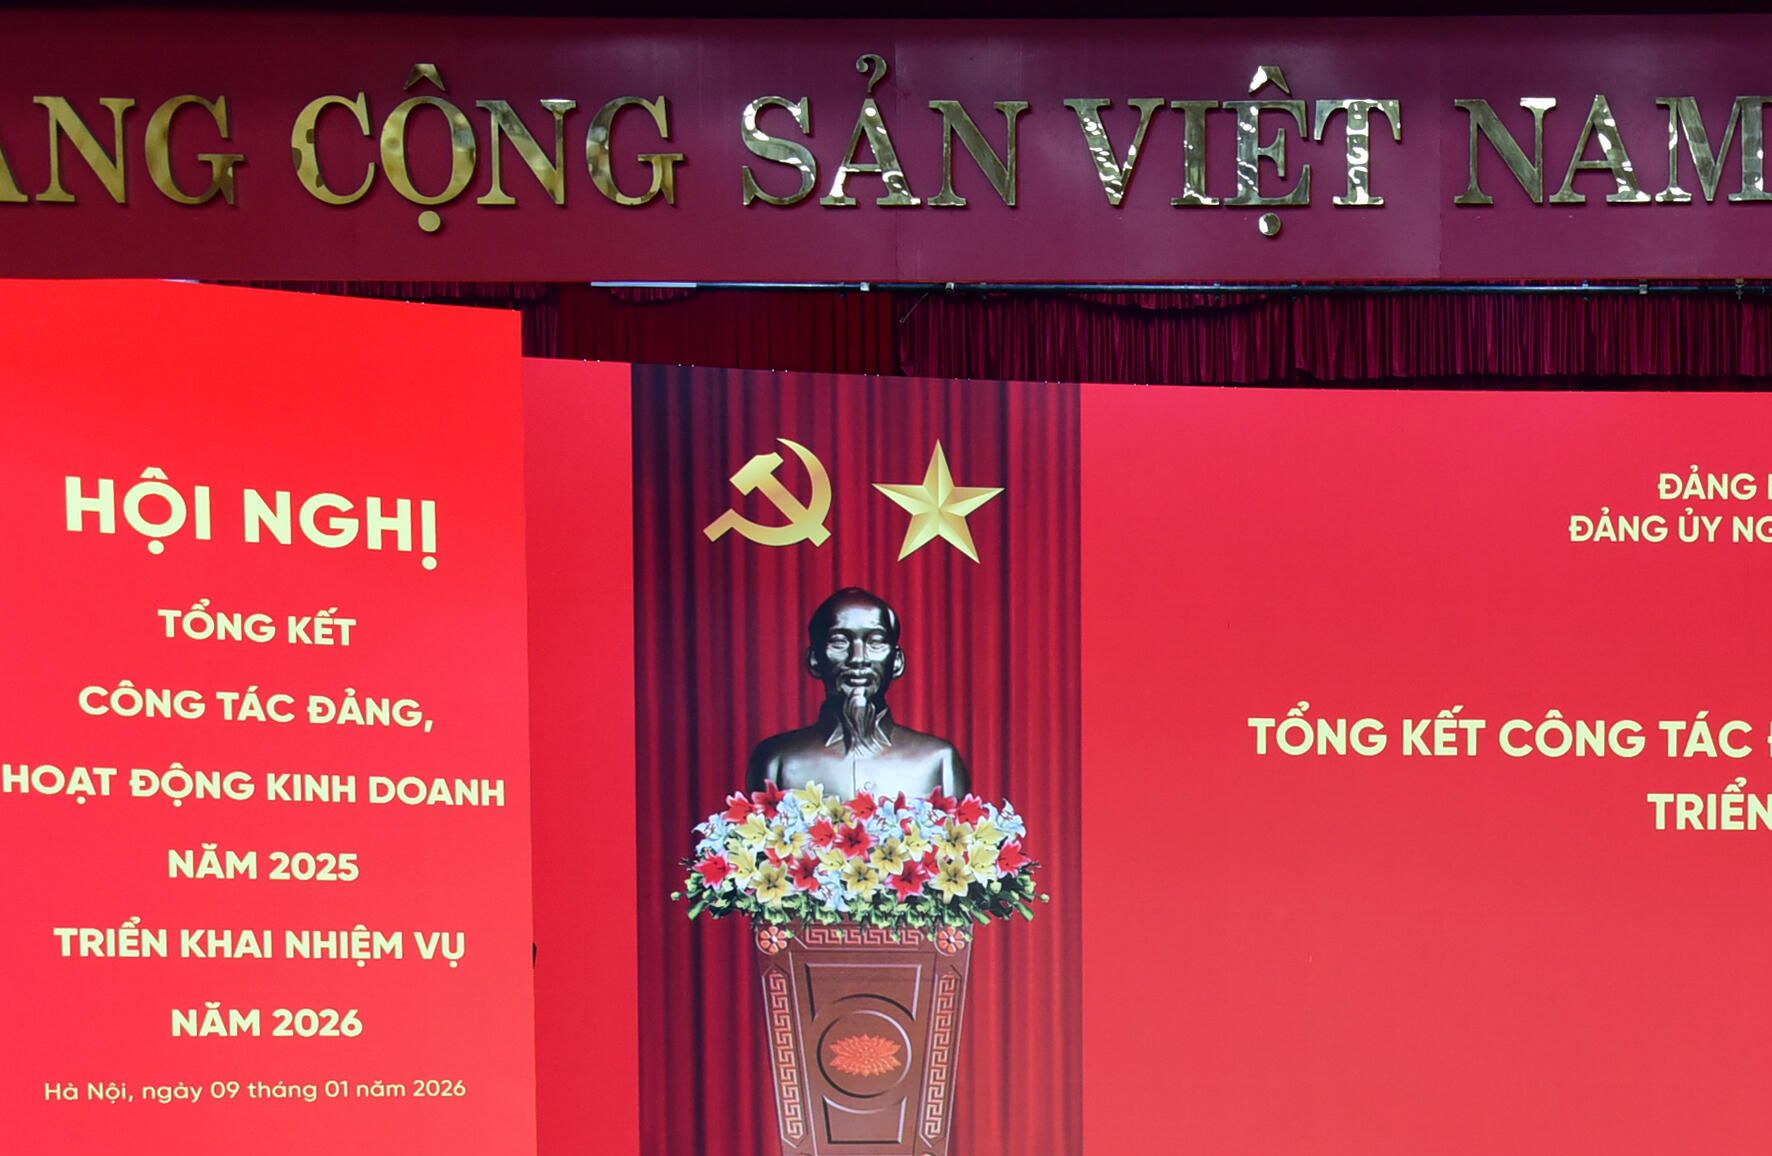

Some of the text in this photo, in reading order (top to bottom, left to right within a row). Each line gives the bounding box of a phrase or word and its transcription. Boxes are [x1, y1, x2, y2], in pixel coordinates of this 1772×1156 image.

[0, 94, 245, 206] NG
[291, 63, 685, 233] CỘNG
[740, 53, 1030, 207] SẢN
[1063, 64, 1401, 237] VIỆT
[1657, 464, 1758, 501] ĐẢNG
[64, 466, 438, 571] HỘI NGHỊ
[1568, 506, 1669, 543] ĐẢNG
[1678, 507, 1723, 543] ỦY
[157, 598, 357, 646] TỔNG KẾT
[78, 679, 434, 733] CÔNG TÁC ĐẢNG,
[1247, 700, 1388, 757] TỔNG
[1402, 704, 1487, 757] KẾT
[1498, 709, 1646, 758] CÔNG
[1658, 710, 1753, 759] TÁC
[2, 762, 505, 808] HOẠT ĐỘNG KINH DOANH
[168, 842, 360, 882] NĂM 2025
[53, 915, 465, 969] TRIỂN KHAI NHIỆM VỤ
[171, 1001, 363, 1038] NĂM 2026
[44, 1079, 467, 1104] Hà Nội, ngày 09 tháng 01 năm 2026
